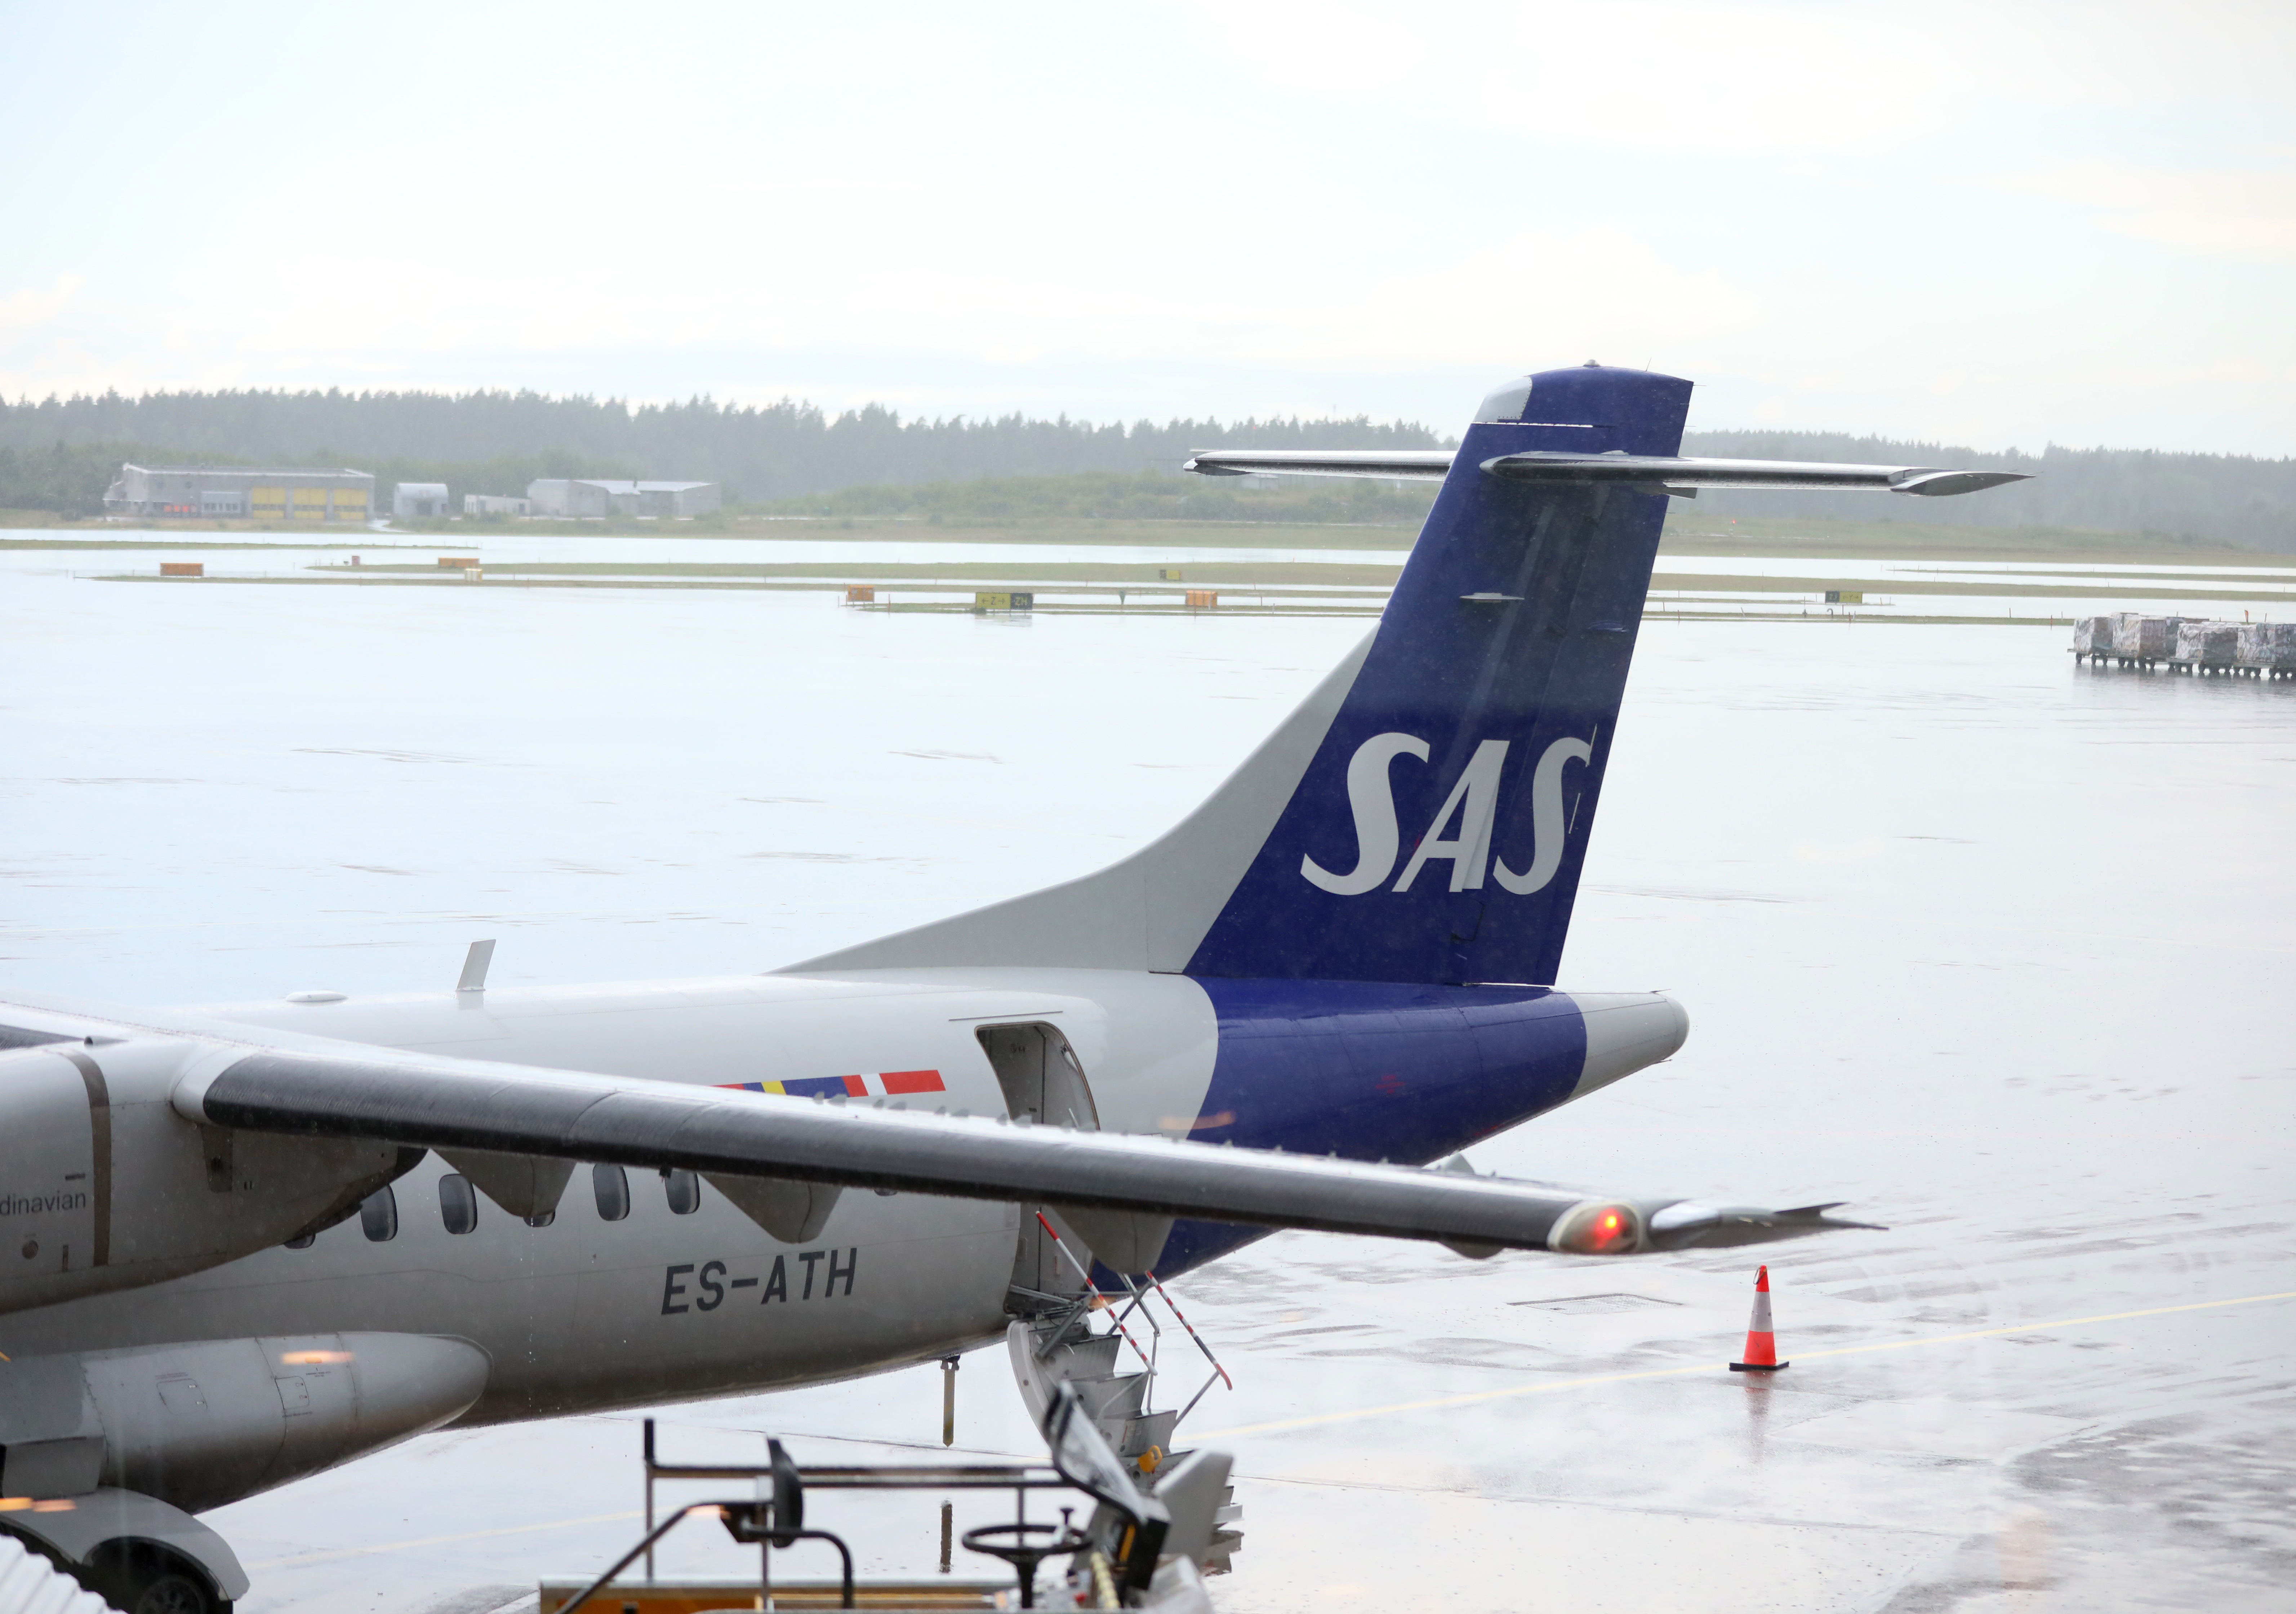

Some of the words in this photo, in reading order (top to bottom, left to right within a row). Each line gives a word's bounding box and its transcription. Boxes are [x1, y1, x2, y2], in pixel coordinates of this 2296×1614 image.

[991, 596, 996, 605] Z
[1300, 732, 1590, 895] SAS
[0, 1190, 86, 1216] dinavian
[661, 1248, 857, 1315] ES-ATH
